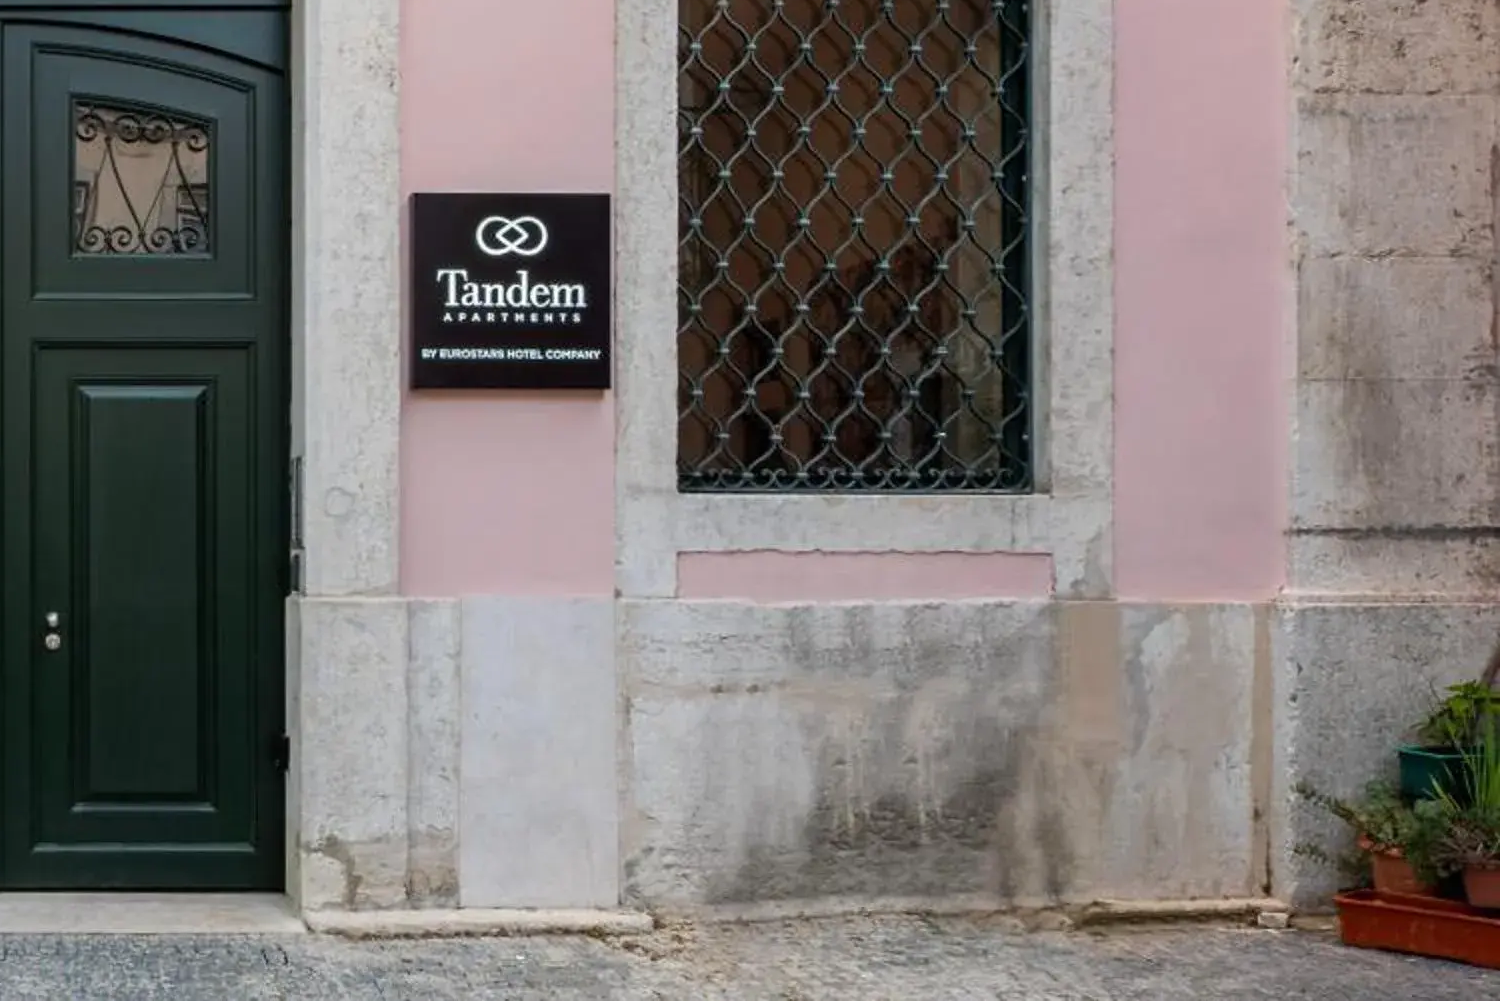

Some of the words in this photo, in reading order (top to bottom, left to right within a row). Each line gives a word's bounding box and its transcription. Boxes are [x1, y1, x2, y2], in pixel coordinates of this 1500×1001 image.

[436, 268, 588, 308] Tandem
[442, 312, 582, 323] APARTMENTS
[507, 348, 543, 360] HOTEL
[545, 348, 601, 360] COMPANY
